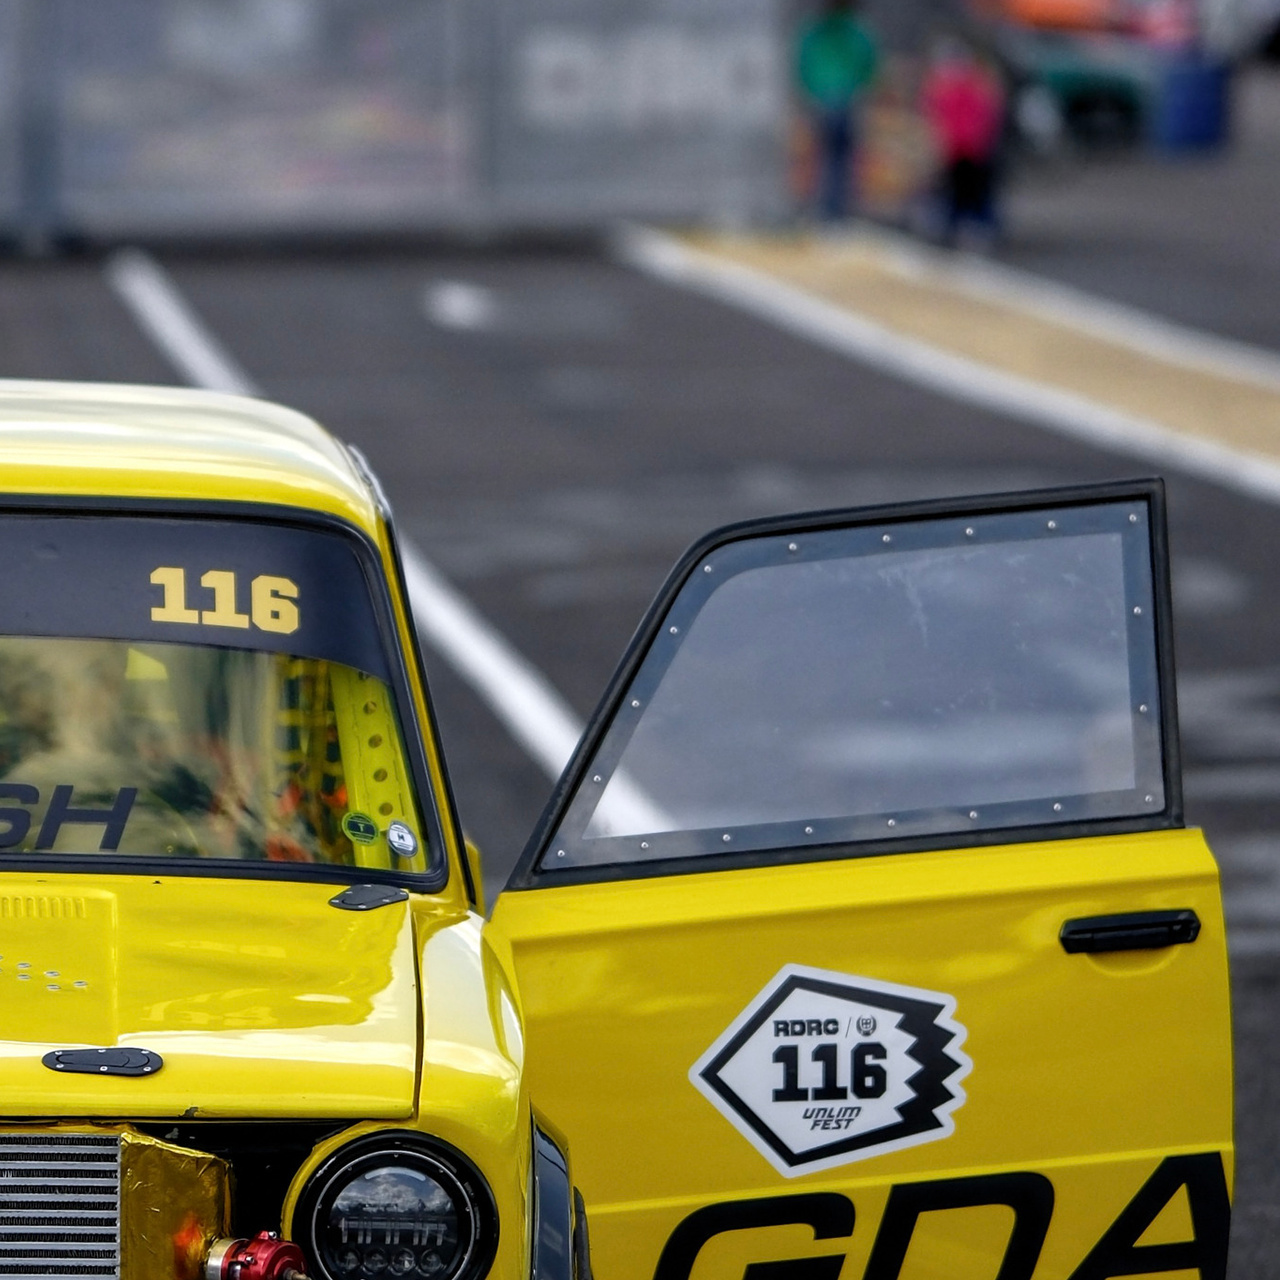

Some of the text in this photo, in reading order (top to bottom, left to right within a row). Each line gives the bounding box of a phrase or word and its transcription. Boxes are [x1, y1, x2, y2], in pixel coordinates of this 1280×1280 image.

[150, 567, 300, 634] 116
[773, 1018, 840, 1037] RDRC
[772, 1041, 888, 1102] 116
[802, 1106, 862, 1120] UNLIM
[810, 1118, 855, 1131] FEST
